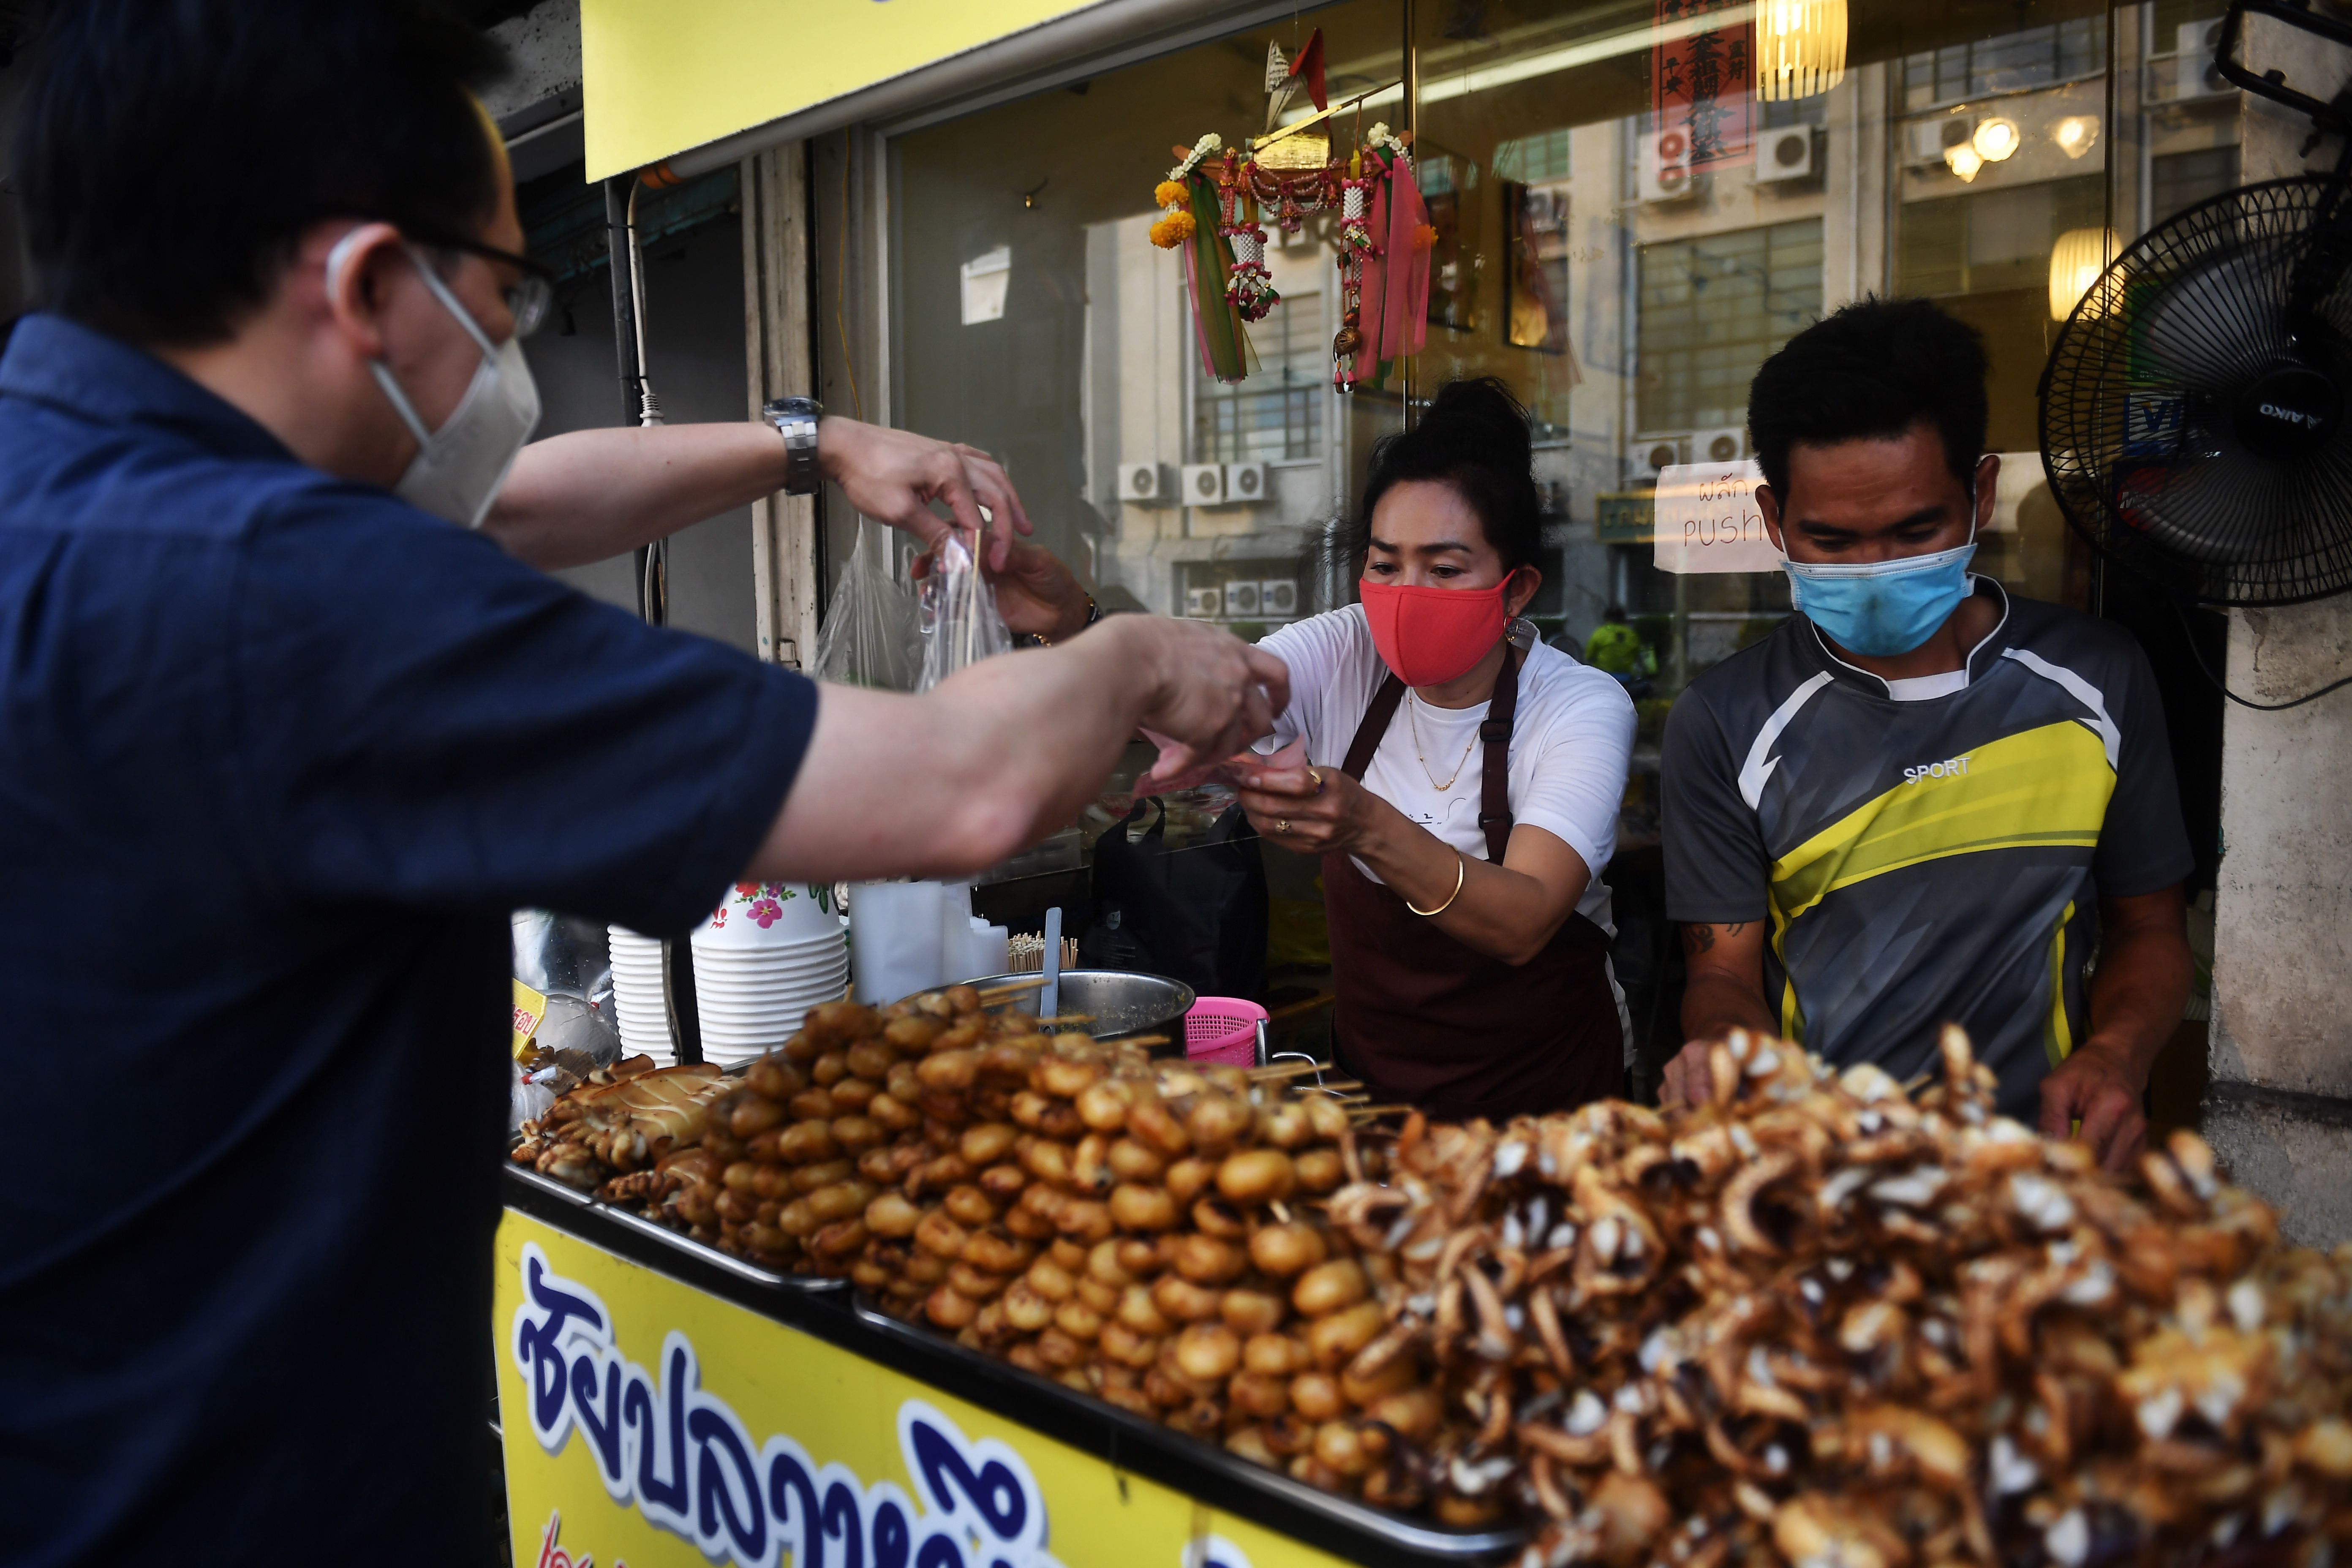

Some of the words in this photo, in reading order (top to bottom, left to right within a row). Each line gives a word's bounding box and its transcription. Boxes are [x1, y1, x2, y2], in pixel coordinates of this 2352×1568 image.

[2259, 403, 2305, 424] AIKO
[1699, 472, 1748, 502] ผลัก
[1903, 757, 1971, 785] SPORT
